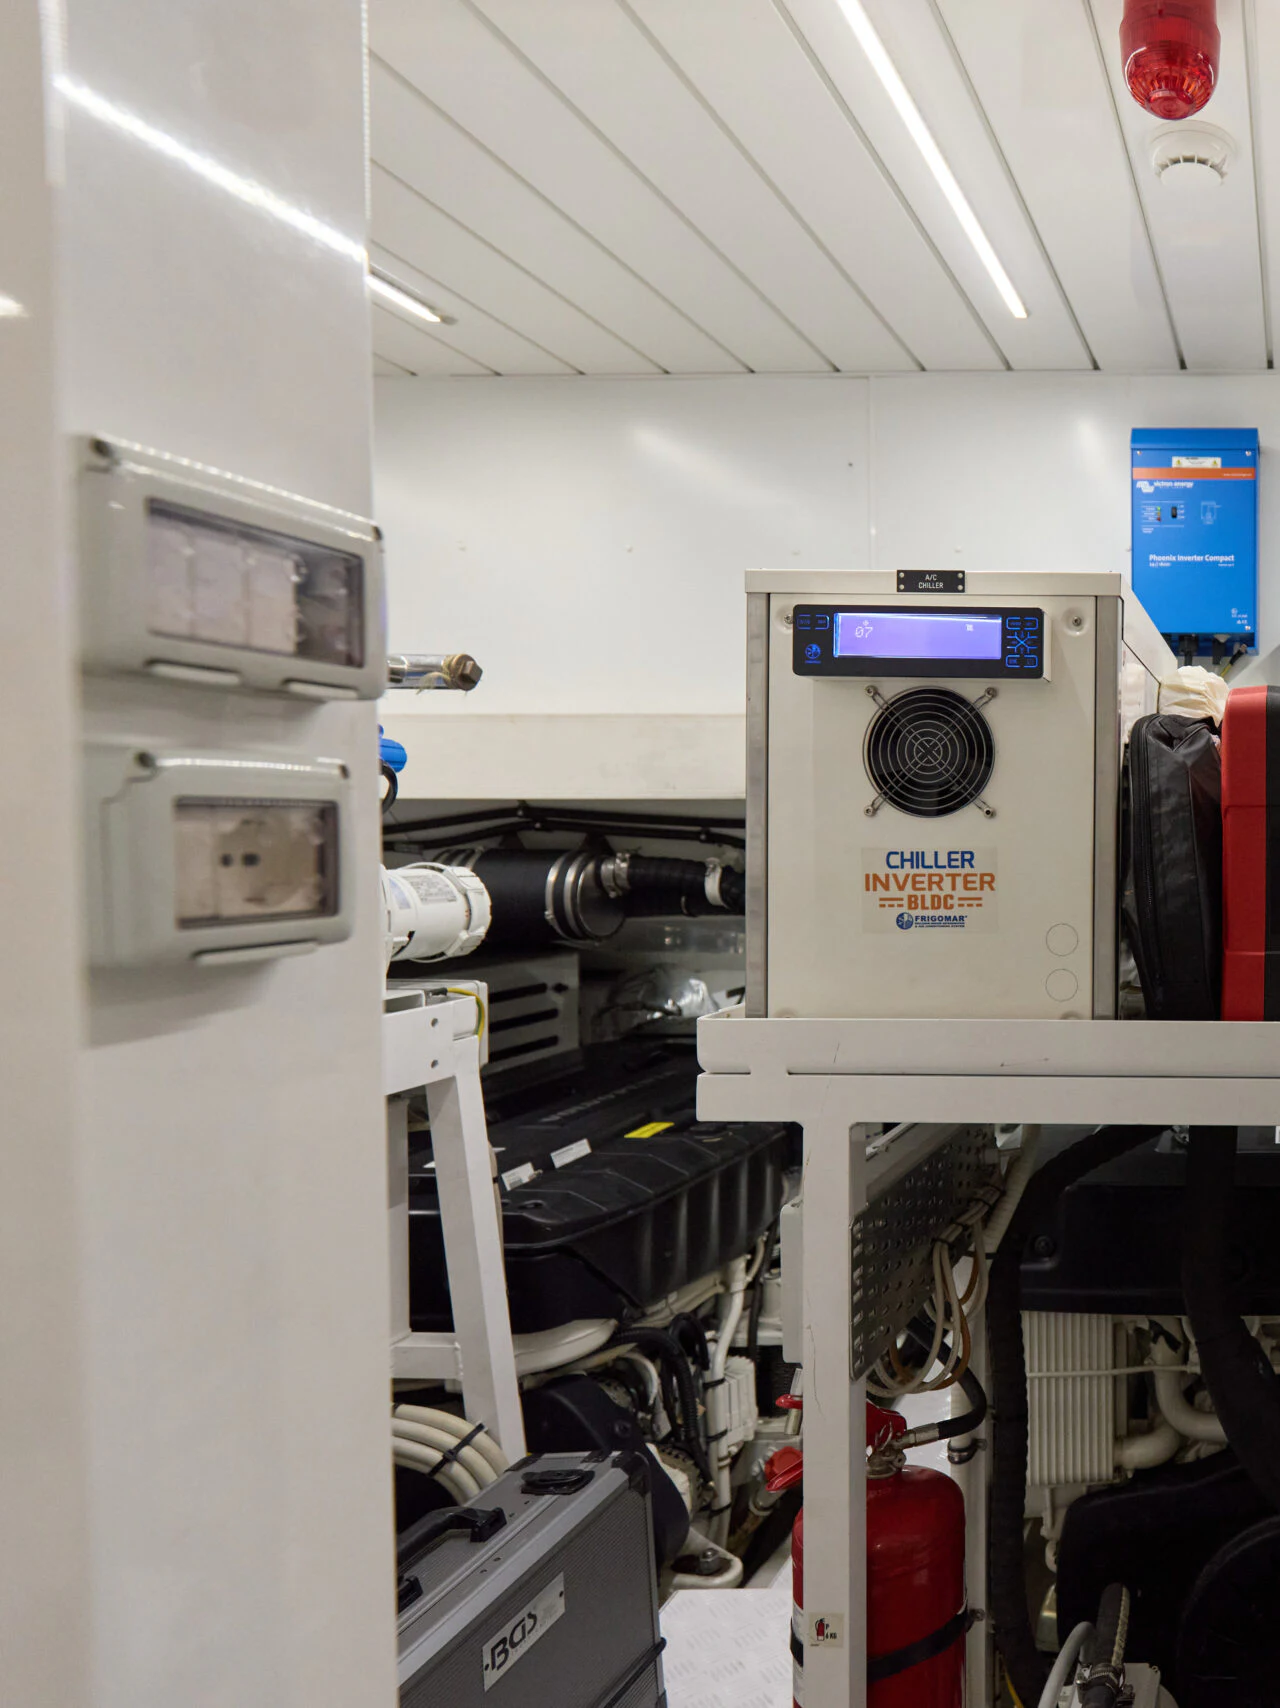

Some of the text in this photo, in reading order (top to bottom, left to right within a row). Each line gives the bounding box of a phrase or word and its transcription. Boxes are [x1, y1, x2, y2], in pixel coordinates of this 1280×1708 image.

[1204, 554, 1235, 563] Compact
[918, 581, 944, 589] CHILLER
[855, 626, 873, 638] 07
[885, 850, 975, 869] CHILLER
[864, 872, 996, 892] INVERTER
[907, 894, 954, 910] BLDC
